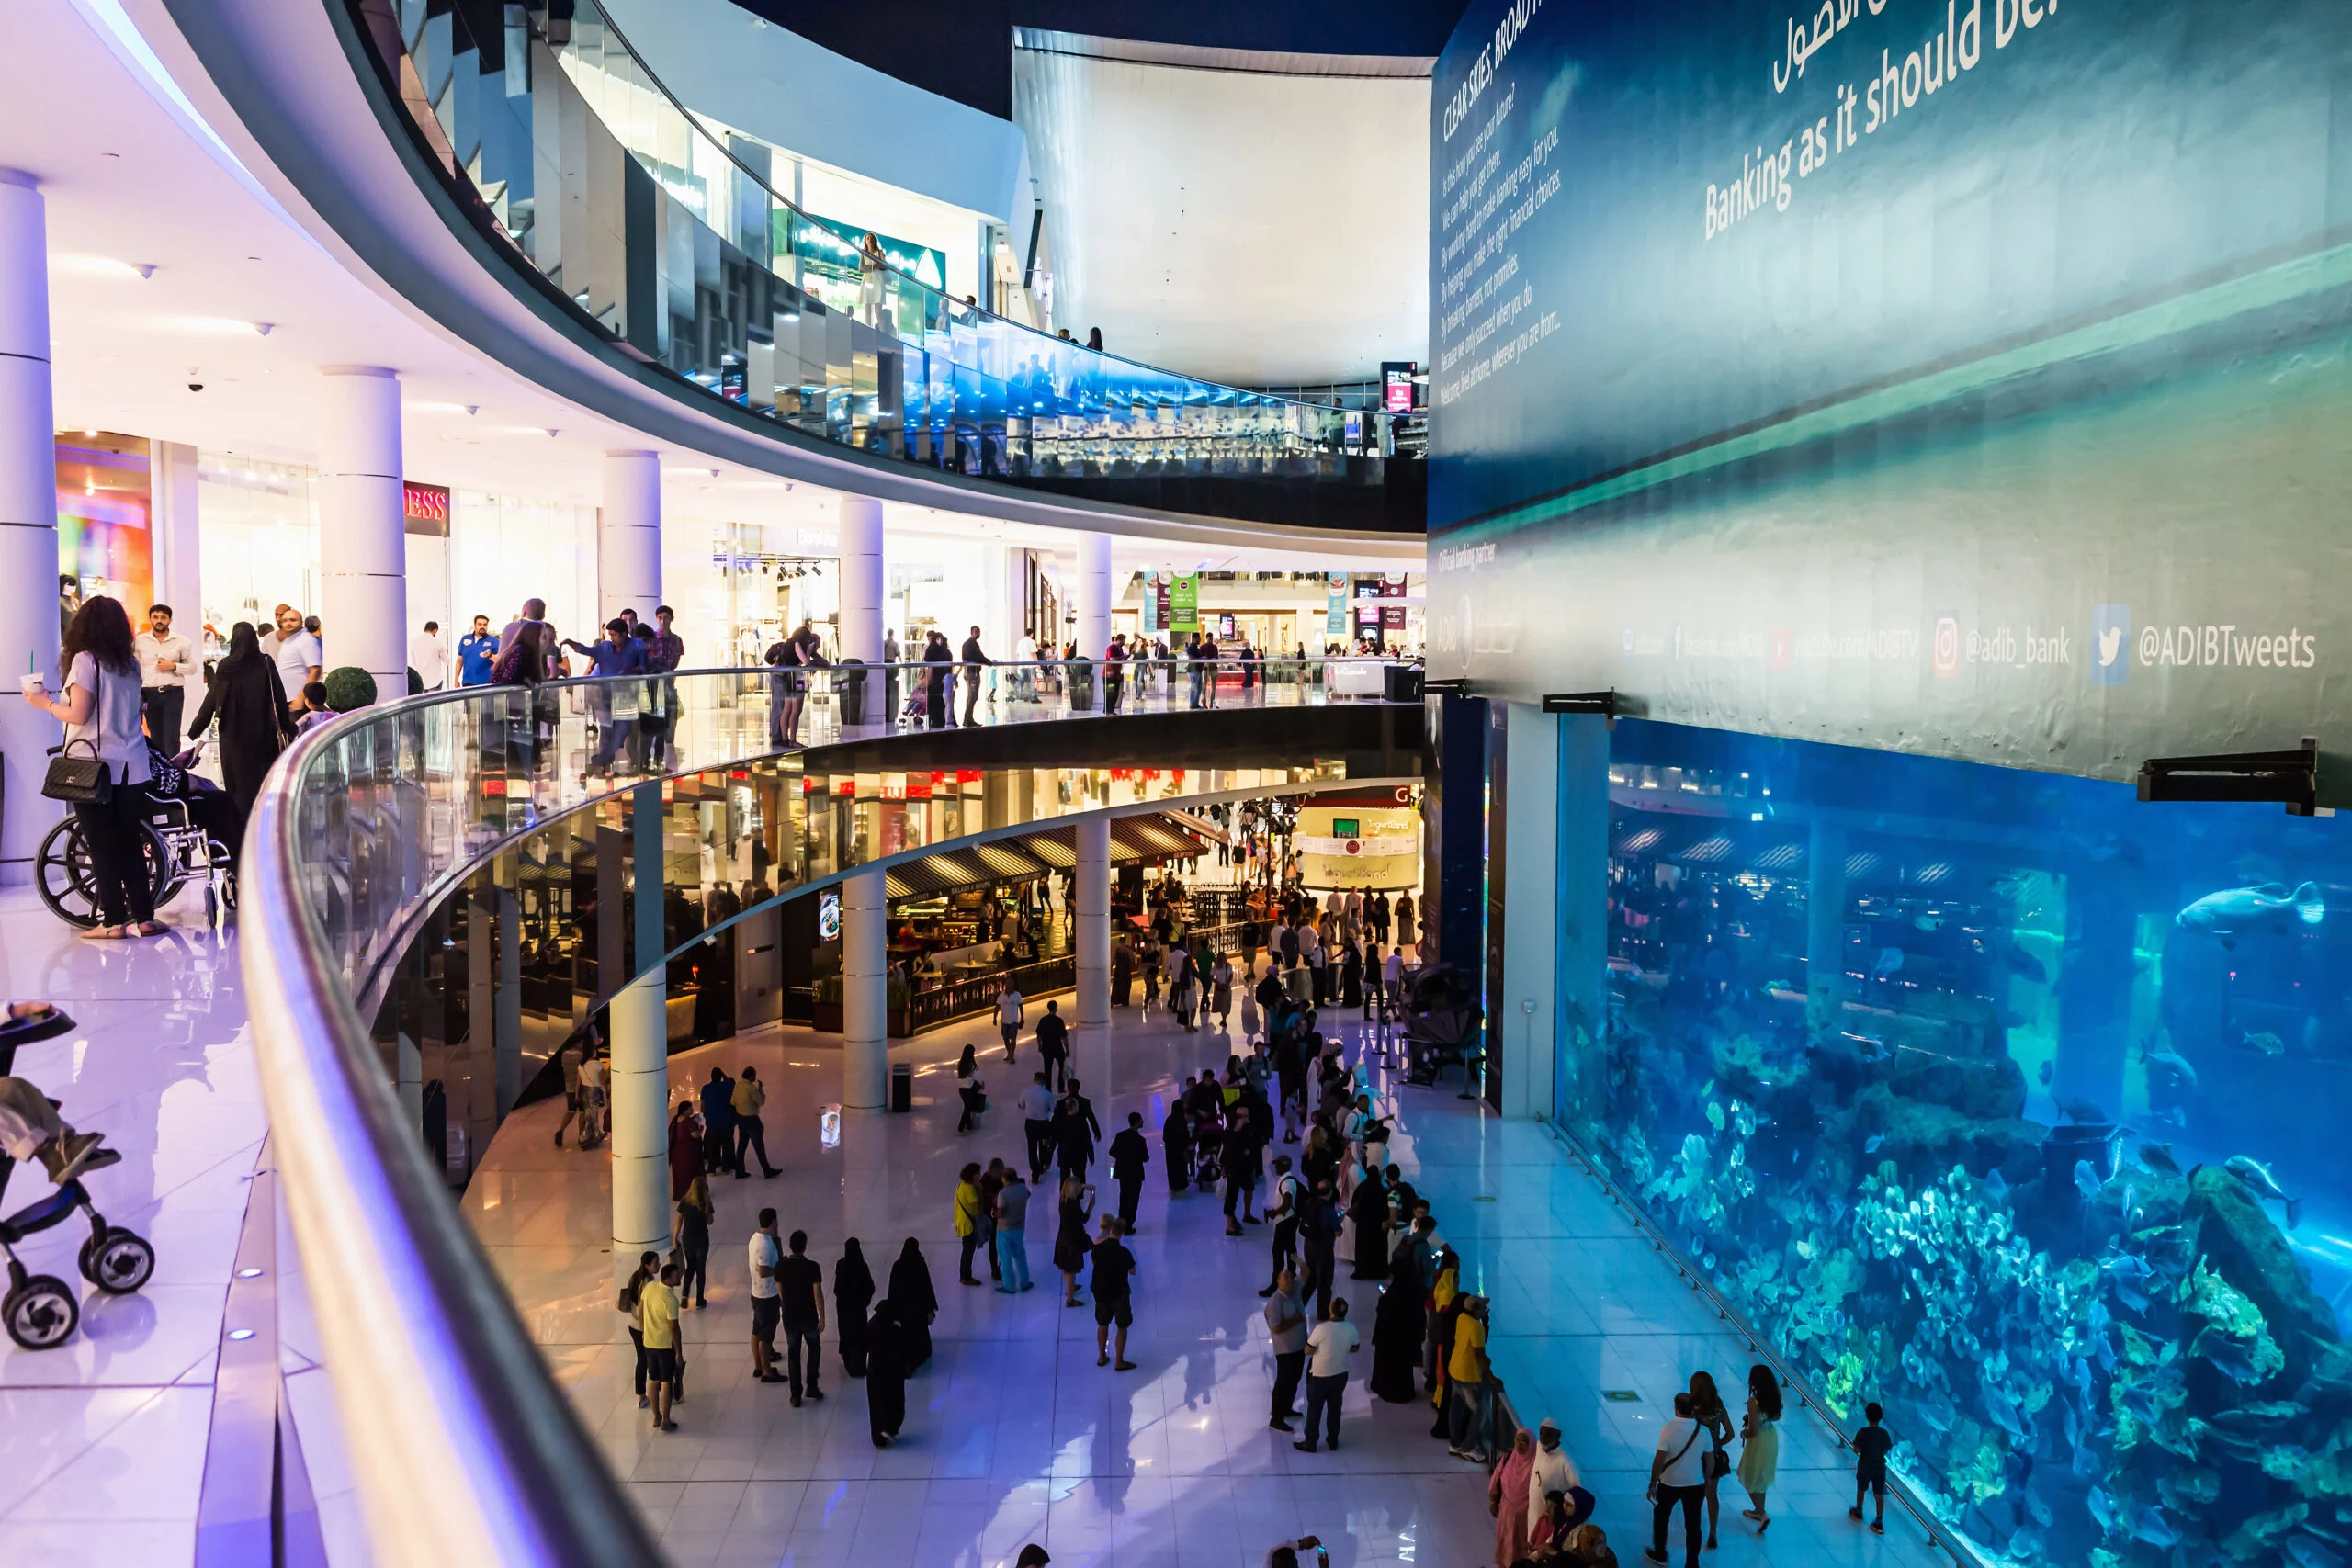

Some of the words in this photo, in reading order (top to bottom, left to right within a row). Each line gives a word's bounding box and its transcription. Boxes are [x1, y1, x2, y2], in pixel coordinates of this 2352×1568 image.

[1443, 81, 1467, 142] CLEAR
[1469, 42, 1492, 108] SKIES,
[1495, 0, 1530, 69] BROAD
[1773, 0, 1859, 94] لصول
[1475, 132, 1484, 156] see
[1483, 114, 1496, 152] your
[1496, 81, 1515, 130] future?
[1706, 139, 1792, 241] Banking
[1799, 117, 1827, 178] as
[1837, 84, 1858, 154] it
[1865, 0, 1981, 134] should
[1468, 177, 1478, 209] you
[1477, 164, 1487, 197] get
[1487, 149, 1501, 179] there.
[1482, 191, 1496, 224] make
[1496, 168, 1518, 208] banking
[1518, 152, 1532, 183] easy
[1533, 140, 1544, 167] for
[1544, 125, 1559, 166] you.
[1495, 216, 1509, 254] right
[1509, 186, 1534, 236] financial
[1534, 168, 1561, 210] choices.
[1493, 254, 1519, 299] promises.
[1476, 306, 1496, 346] succeed
[1496, 300, 1510, 330] when
[1510, 292, 1523, 326] you
[1523, 278, 1533, 308] do.
[1491, 344, 1517, 373] wherever
[1516, 331, 1529, 365] you
[1529, 322, 1539, 347] are
[1475, 542, 1497, 572] partner
[1436, 615, 1456, 652] ADIB
[1792, 627, 1920, 666] youtube.com/ADIBTV
[1966, 626, 2070, 669] @adib_bank
[2139, 625, 2316, 669] @ADIBTweets
[1395, 787, 1408, 803] G
[1125, 858, 1140, 866] PASTA
